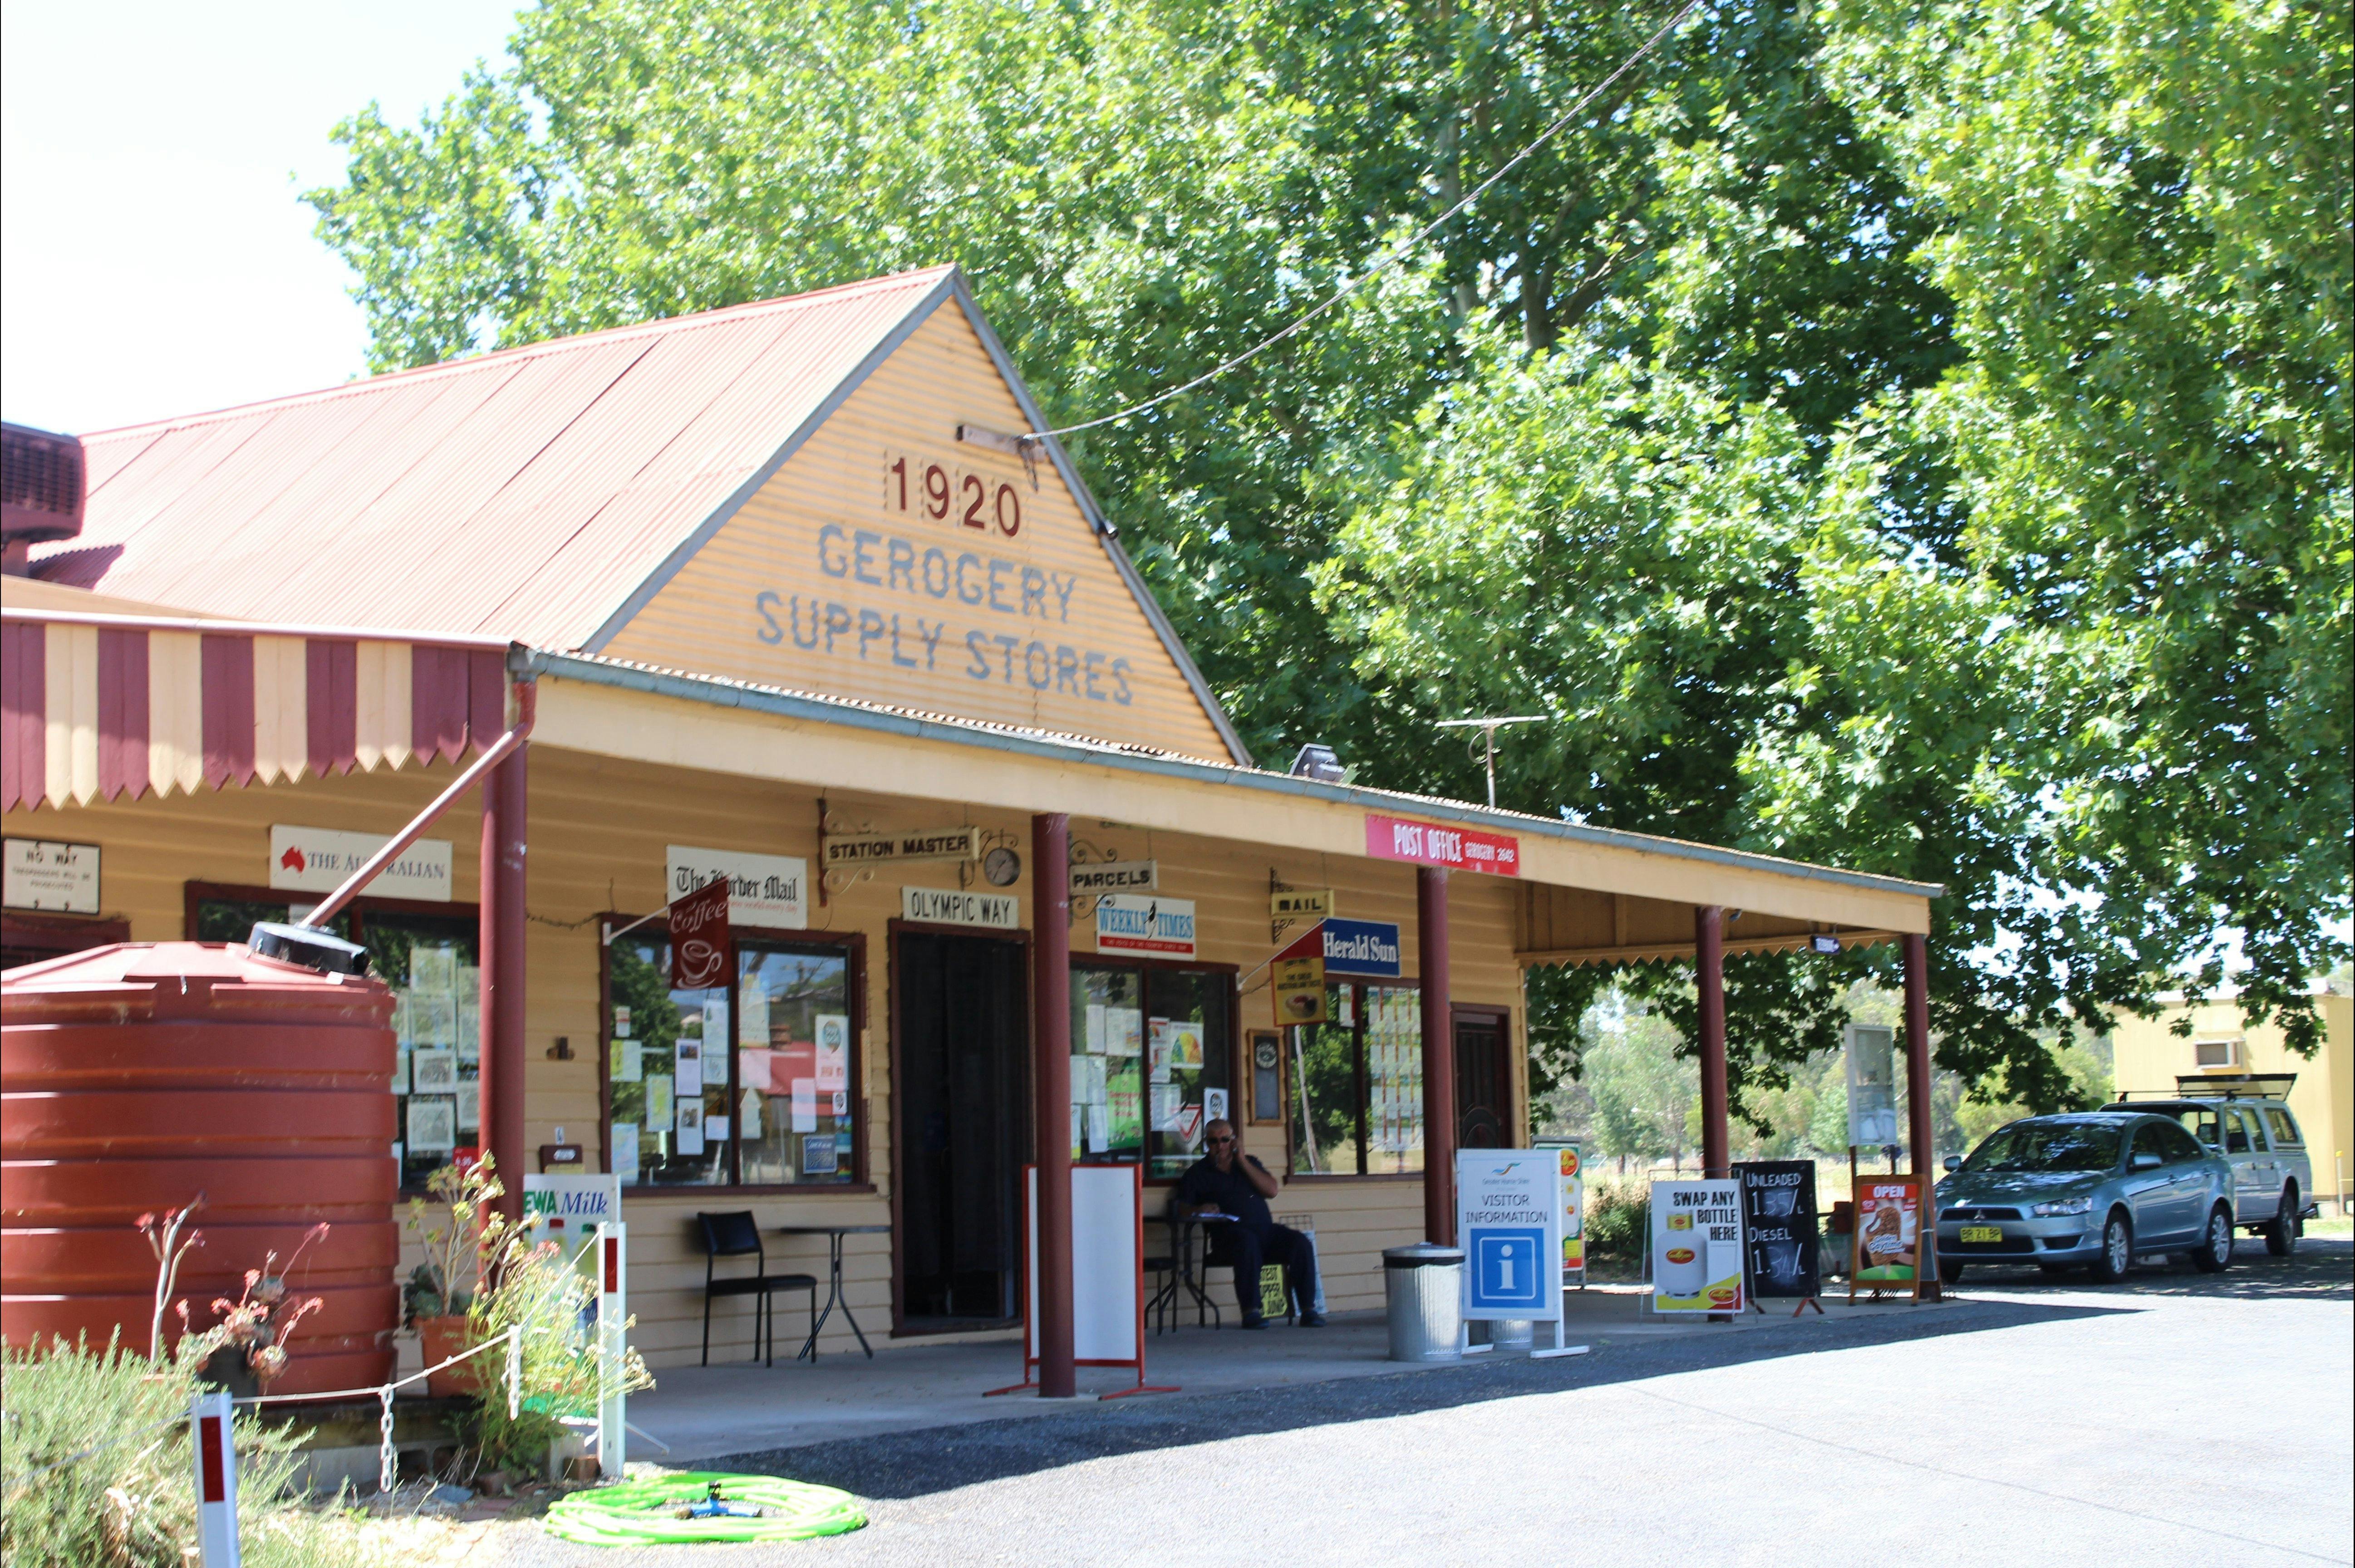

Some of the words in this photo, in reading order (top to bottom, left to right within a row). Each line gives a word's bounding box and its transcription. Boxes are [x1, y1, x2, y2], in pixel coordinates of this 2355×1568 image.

[892, 457, 1020, 537] 1920
[819, 524, 1076, 623] GEROGERY
[756, 591, 944, 670] SUPPLY
[965, 630, 1133, 706] STORES
[829, 841, 894, 859] STATION
[903, 835, 969, 854] MASTER
[1393, 823, 1423, 858] POST
[1427, 828, 1463, 862] OFFICE
[26, 849, 44, 863] NO
[54, 853, 78, 866] WAY
[308, 851, 339, 870] THE
[344, 852, 445, 879] AURALIAN
[676, 866, 707, 893] The
[763, 874, 800, 902] Mail
[1072, 870, 1150, 888] PARCELS
[671, 897, 728, 934] Coffee
[911, 892, 974, 922] OLYMPIC
[980, 898, 1010, 924] WAY
[1278, 897, 1322, 911] MAIL
[1099, 908, 1148, 935] WEEKLY
[1157, 913, 1194, 939] TIMES
[1322, 931, 1370, 960] Herald
[1370, 936, 1398, 962] Sun
[1747, 1172, 1802, 1187] UNLEADED
[1873, 1185, 1906, 1198] OPEN
[524, 1190, 557, 1214] EWA
[560, 1190, 608, 1215] Milk
[1481, 1194, 1530, 1207] VISITOR
[1673, 1191, 1707, 1206] SWAP
[1711, 1191, 1735, 1206] ANY
[1465, 1210, 1548, 1224] INFORMATION
[1697, 1209, 1737, 1224] BOTTLE
[1710, 1226, 1737, 1241] HERE
[1750, 1226, 1793, 1243] DIESEL
